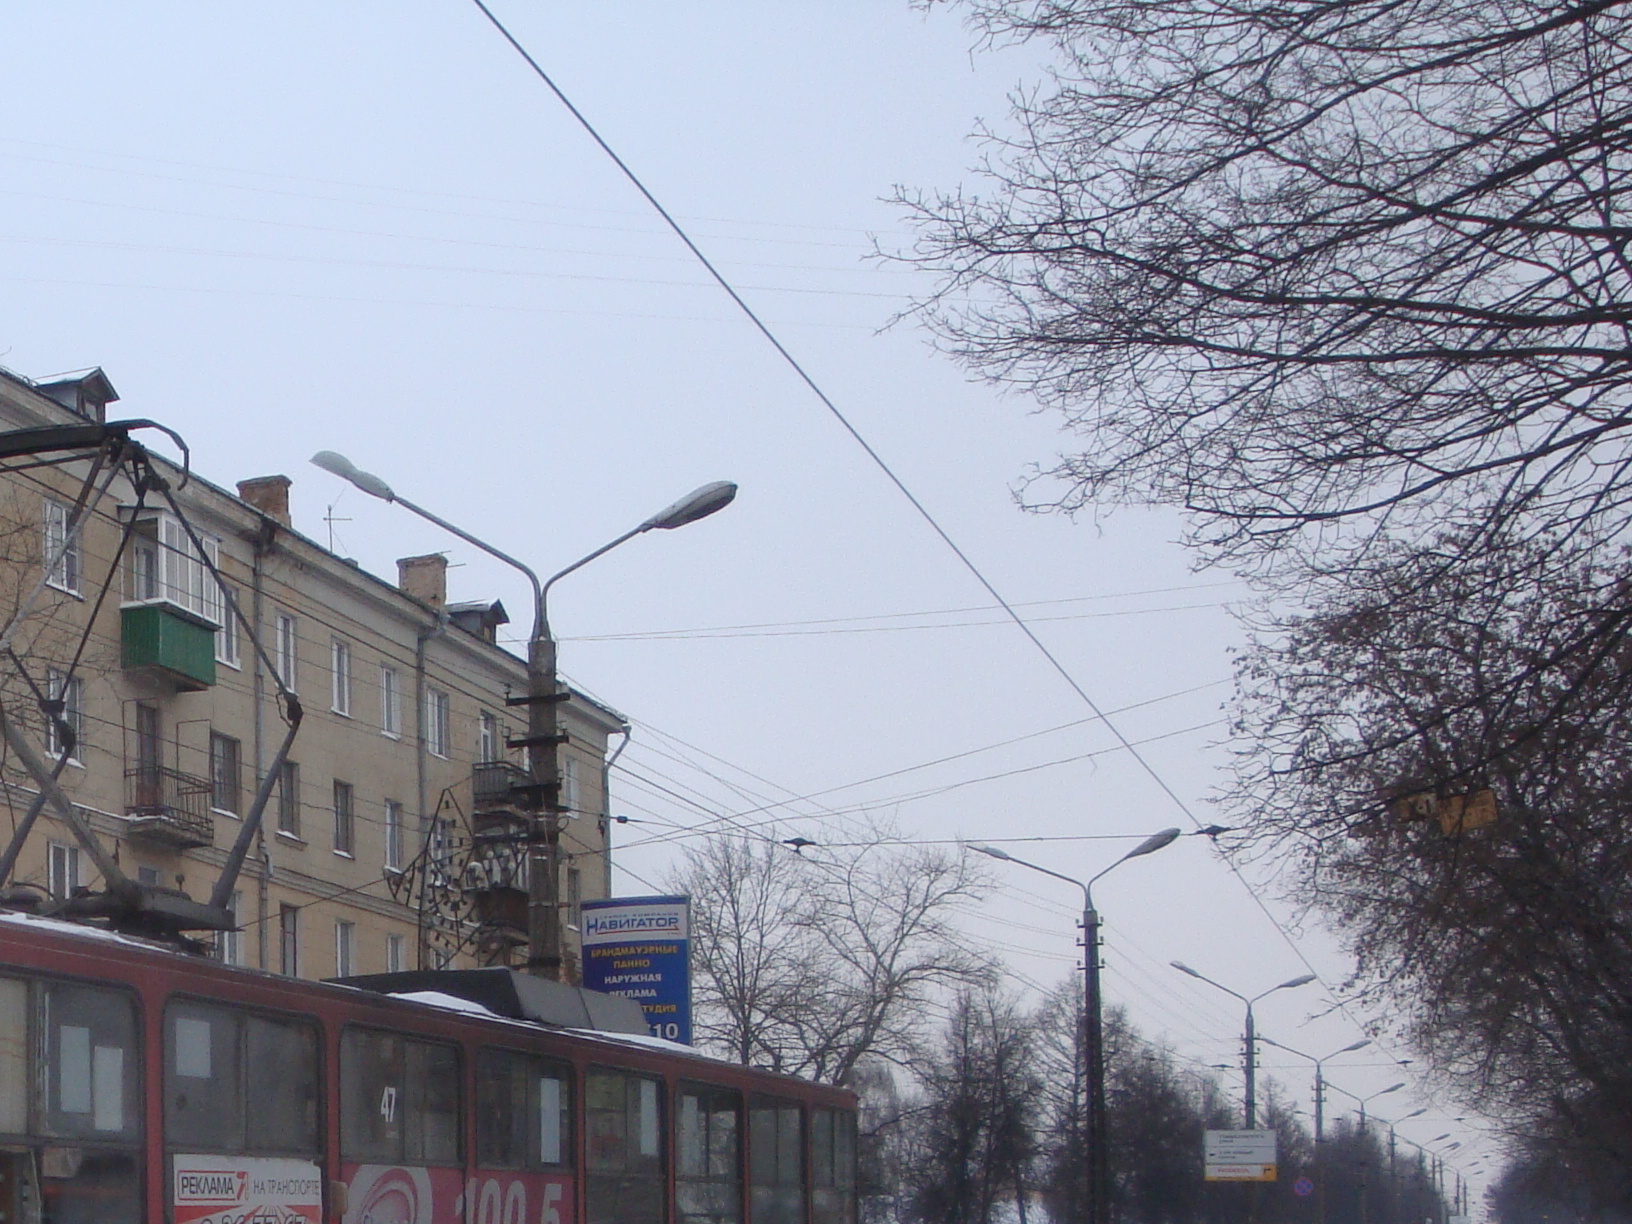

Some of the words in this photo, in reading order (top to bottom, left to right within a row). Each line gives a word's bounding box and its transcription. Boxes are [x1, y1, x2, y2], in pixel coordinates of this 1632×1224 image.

[613, 960, 650, 969] ПАННО
[604, 973, 662, 985] НАРУЖНАЯ
[642, 1004, 676, 1014] ТУДИЯ
[649, 1022, 679, 1040] 10
[381, 1086, 396, 1123] 47
[181, 1176, 234, 1195] РЕКЛАМА
[253, 1179, 266, 1196] НА
[267, 1179, 320, 1196] ТРАНСПОРТЕ
